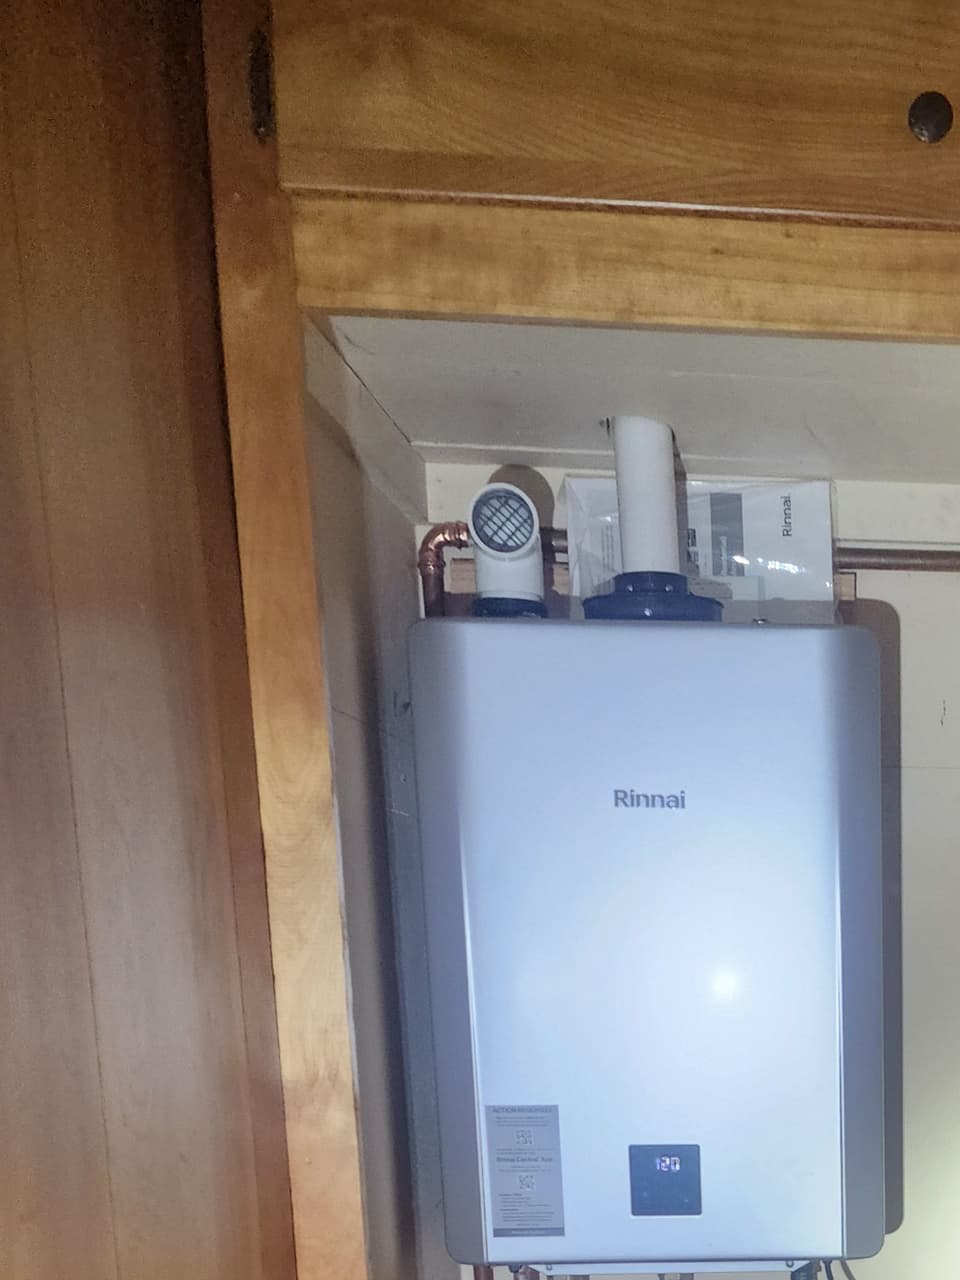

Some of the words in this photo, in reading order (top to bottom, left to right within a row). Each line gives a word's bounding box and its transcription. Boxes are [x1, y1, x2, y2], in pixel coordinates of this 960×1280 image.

[781, 495, 792, 537] Rinnai
[613, 789, 686, 809] Rinnai
[656, 1156, 680, 1172] 120
